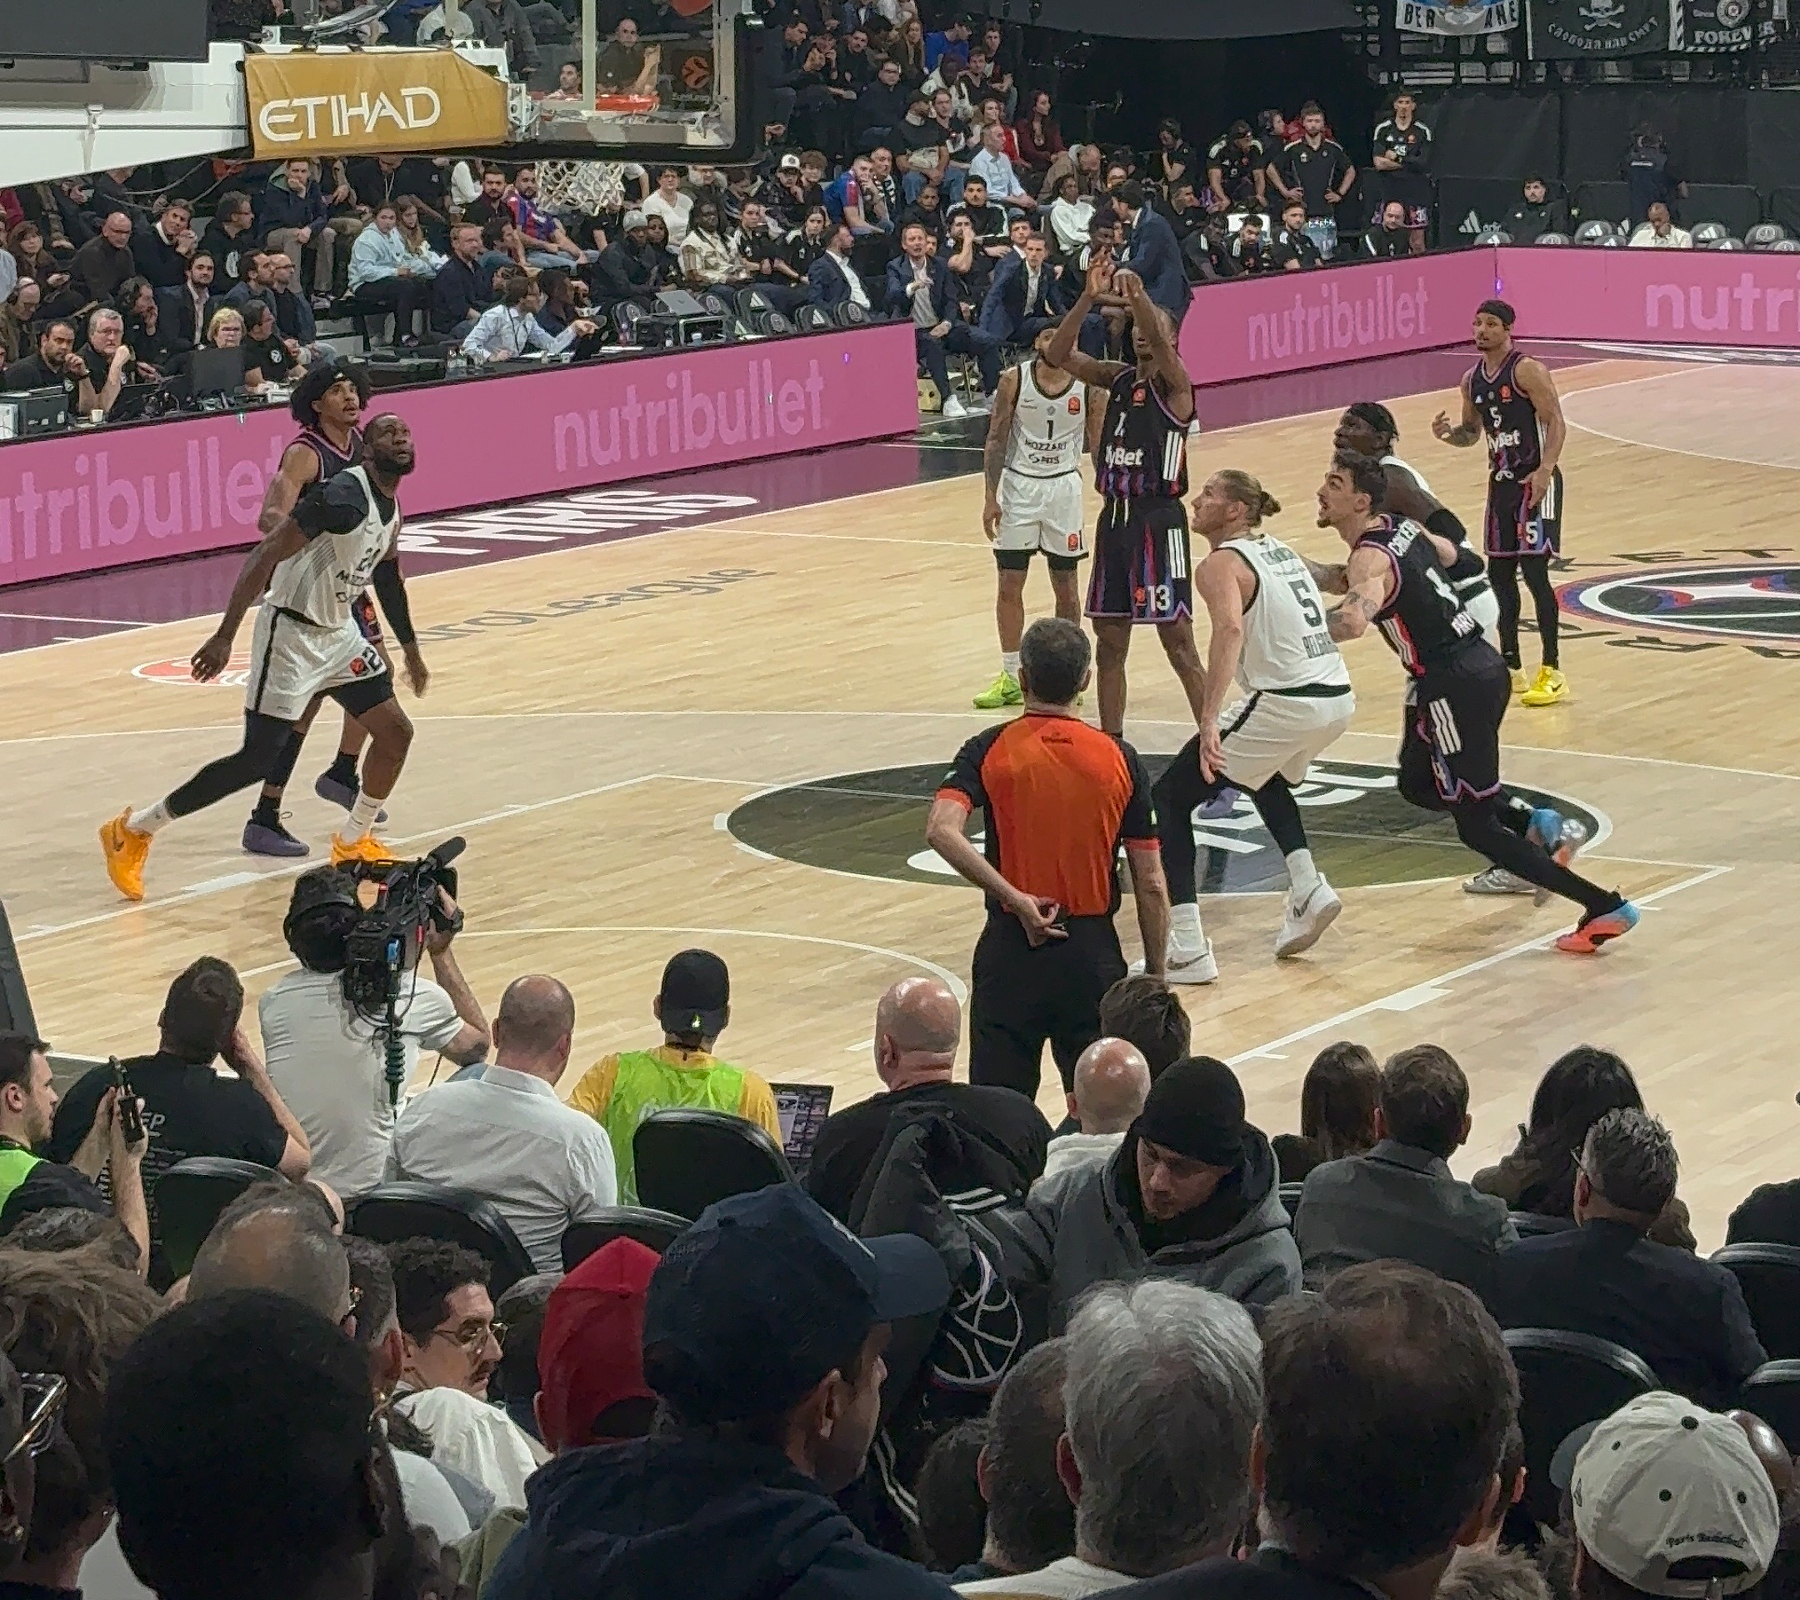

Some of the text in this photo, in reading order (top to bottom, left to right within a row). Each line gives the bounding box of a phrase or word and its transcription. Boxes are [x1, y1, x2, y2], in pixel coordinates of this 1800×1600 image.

[259, 86, 441, 142] ETIHAD
[1248, 275, 1428, 362] nutribullet
[1646, 269, 1800, 332] nutr
[553, 359, 825, 472] nutribullet
[1047, 420, 1054, 440] 1
[1490, 406, 1502, 427] 5
[397, 489, 760, 555] PARIS
[1525, 521, 1538, 544] 5
[384, 566, 778, 652] uroLeague
[1147, 584, 1170, 612] 13
[1288, 579, 1322, 628] 5
